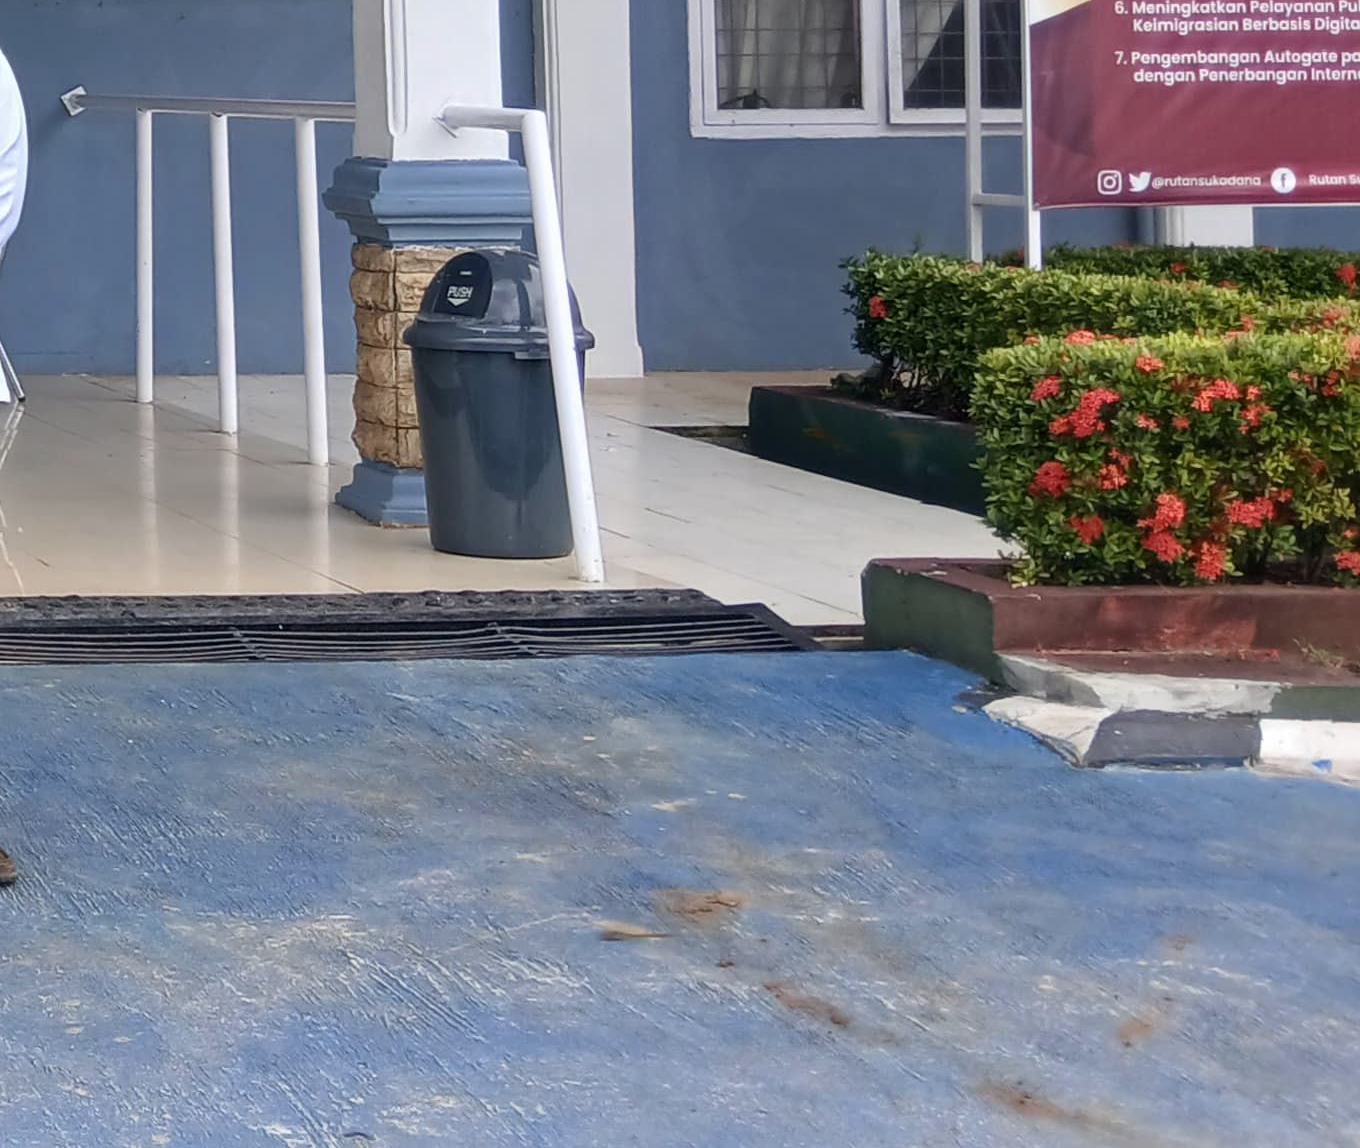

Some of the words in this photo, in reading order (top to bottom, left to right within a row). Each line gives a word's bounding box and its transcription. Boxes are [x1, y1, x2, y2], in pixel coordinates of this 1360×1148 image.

[1114, 1, 1128, 15] 6.
[1132, 1, 1246, 17] Meningkatkan
[1250, 0, 1335, 17] Pelayanan
[1338, 0, 1360, 13] Pu
[1133, 18, 1238, 35] Keimigrasian
[1242, 17, 1311, 31] Berbasis
[1115, 52, 1127, 65] 7.
[1131, 51, 1260, 68] Pengembangan
[1264, 50, 1338, 67] Autogate
[1134, 69, 1195, 86] dengan
[1199, 68, 1308, 85] Penerbangan
[1311, 68, 1360, 81] Intern
[1152, 175, 1261, 189] @rutansukadana
[1309, 174, 1346, 186] Rutan
